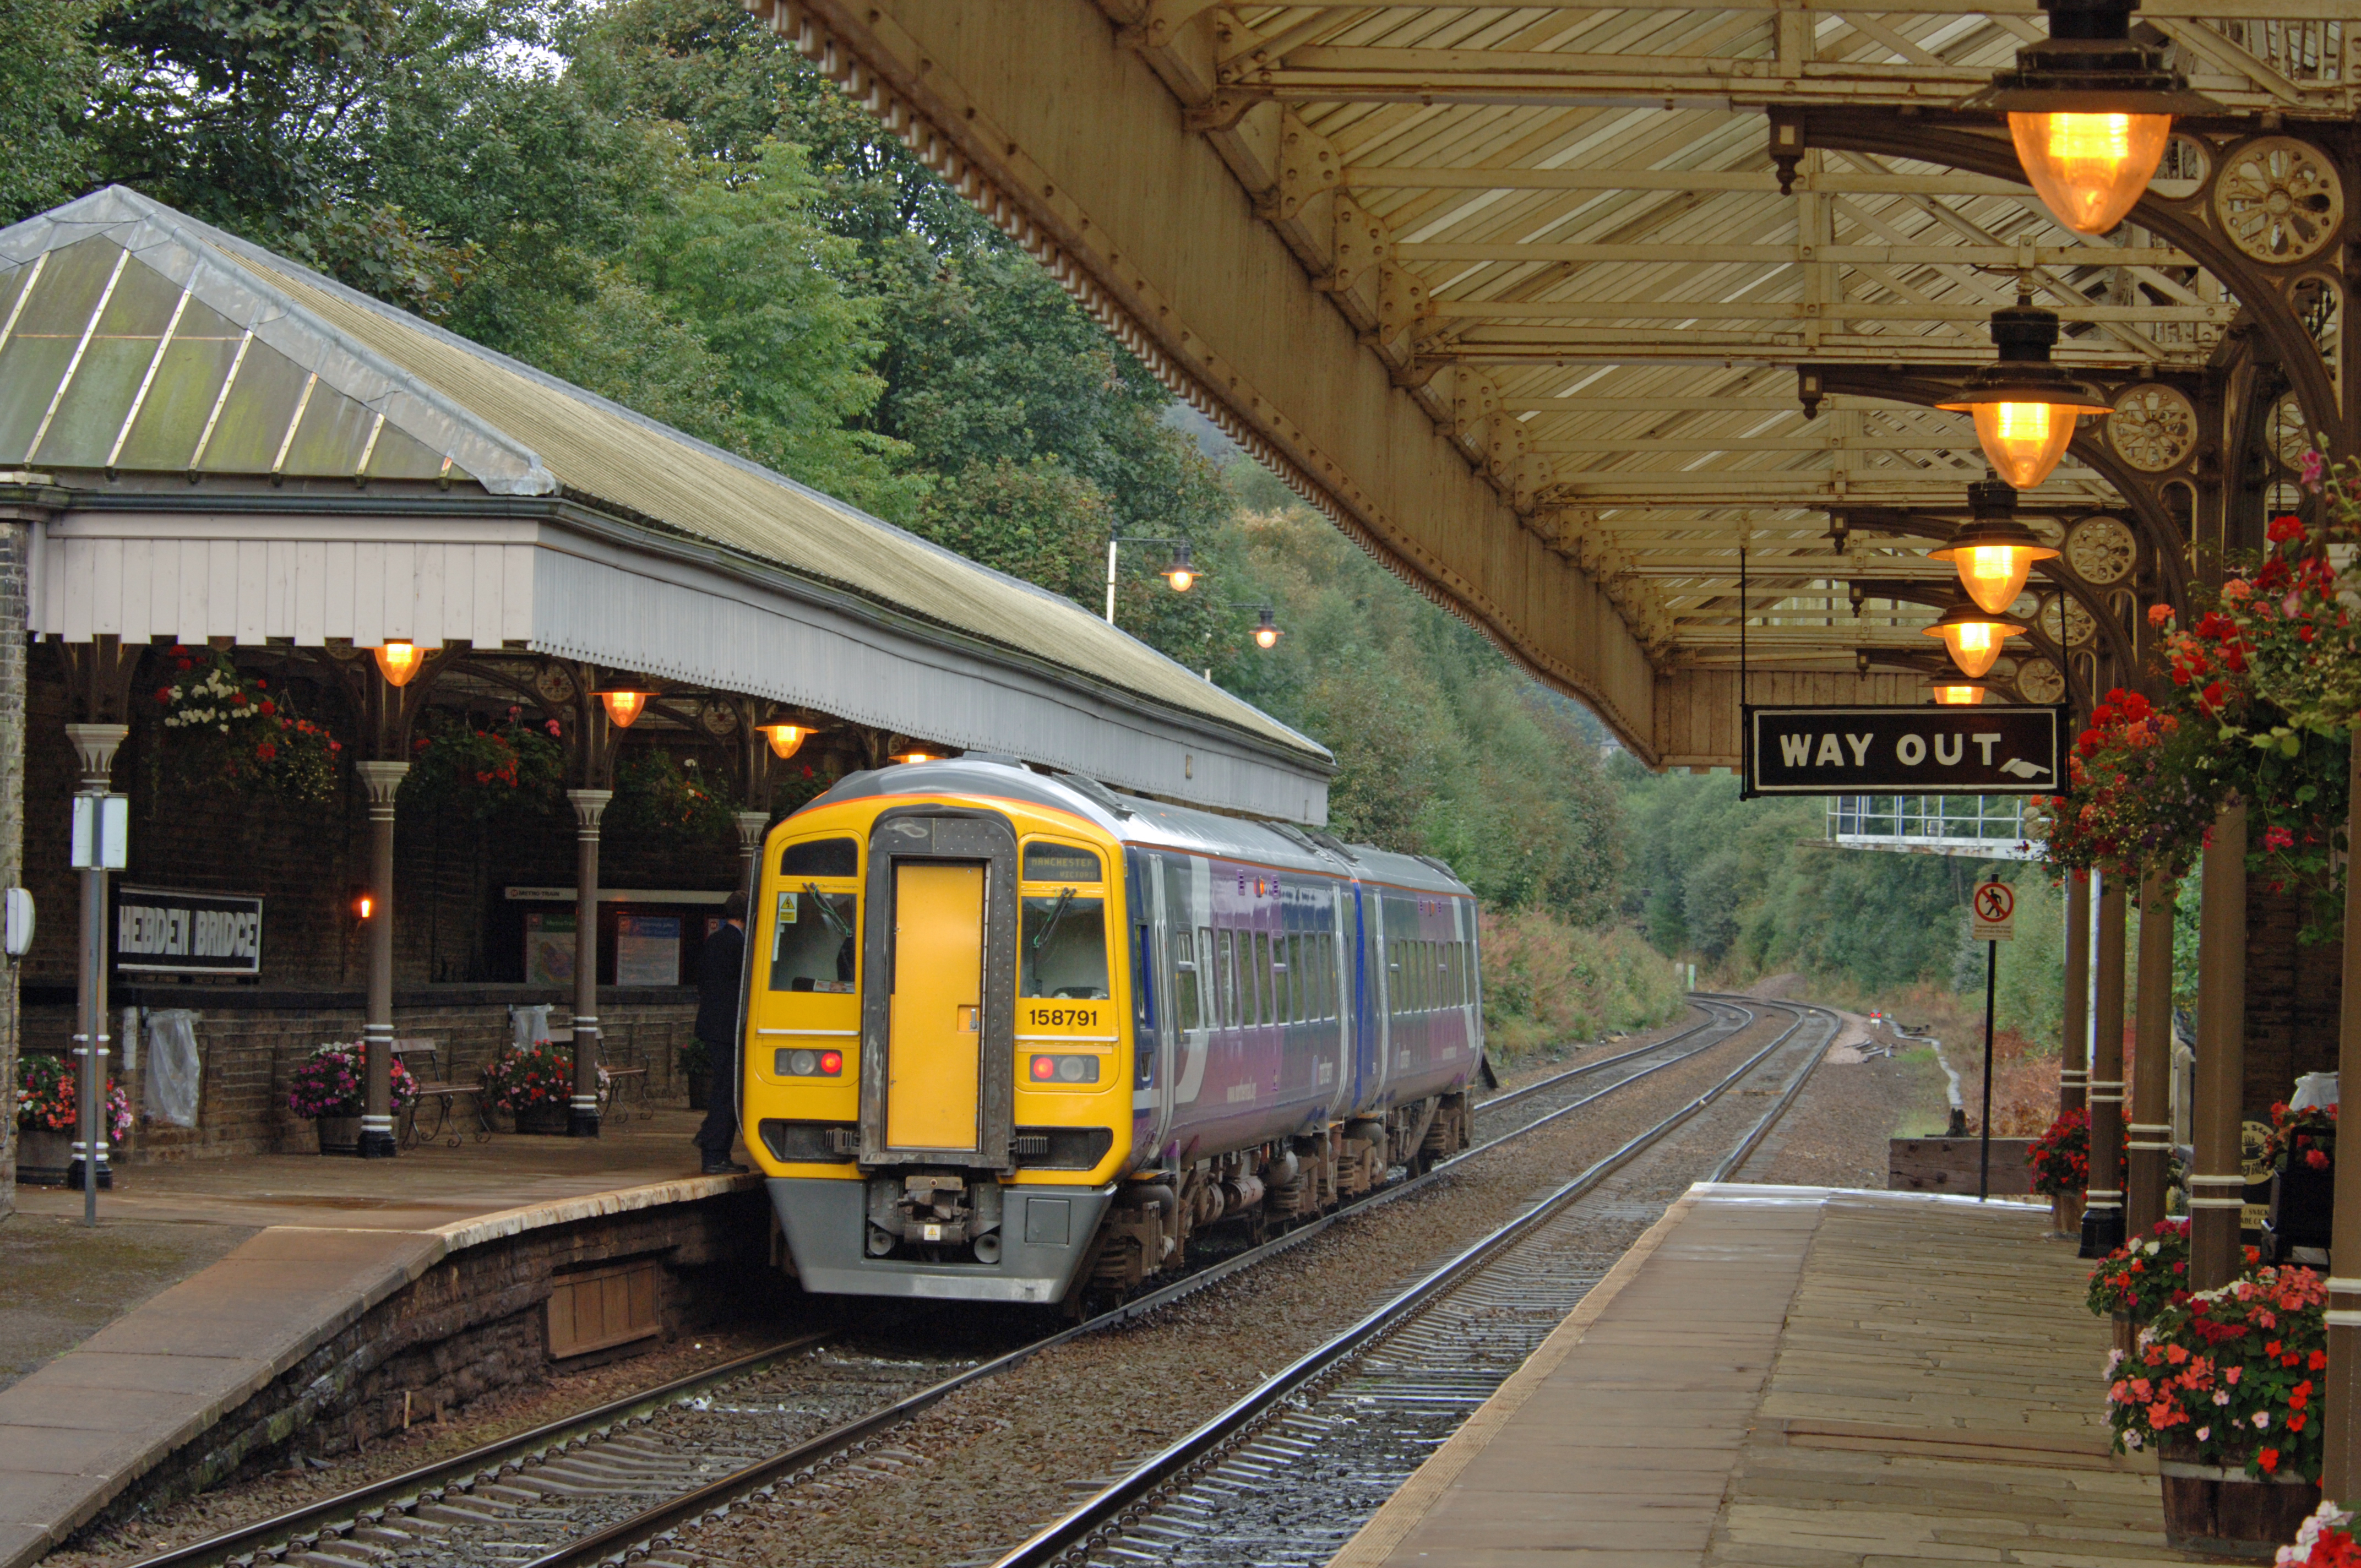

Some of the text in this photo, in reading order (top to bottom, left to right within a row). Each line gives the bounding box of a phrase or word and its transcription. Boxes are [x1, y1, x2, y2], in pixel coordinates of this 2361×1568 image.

[1780, 733, 2001, 767] WAY OUT
[1031, 858, 1093, 867] MANCHESTER
[118, 906, 257, 957] HEBDEN BRIDGE
[1029, 1009, 1097, 1026] 158791
